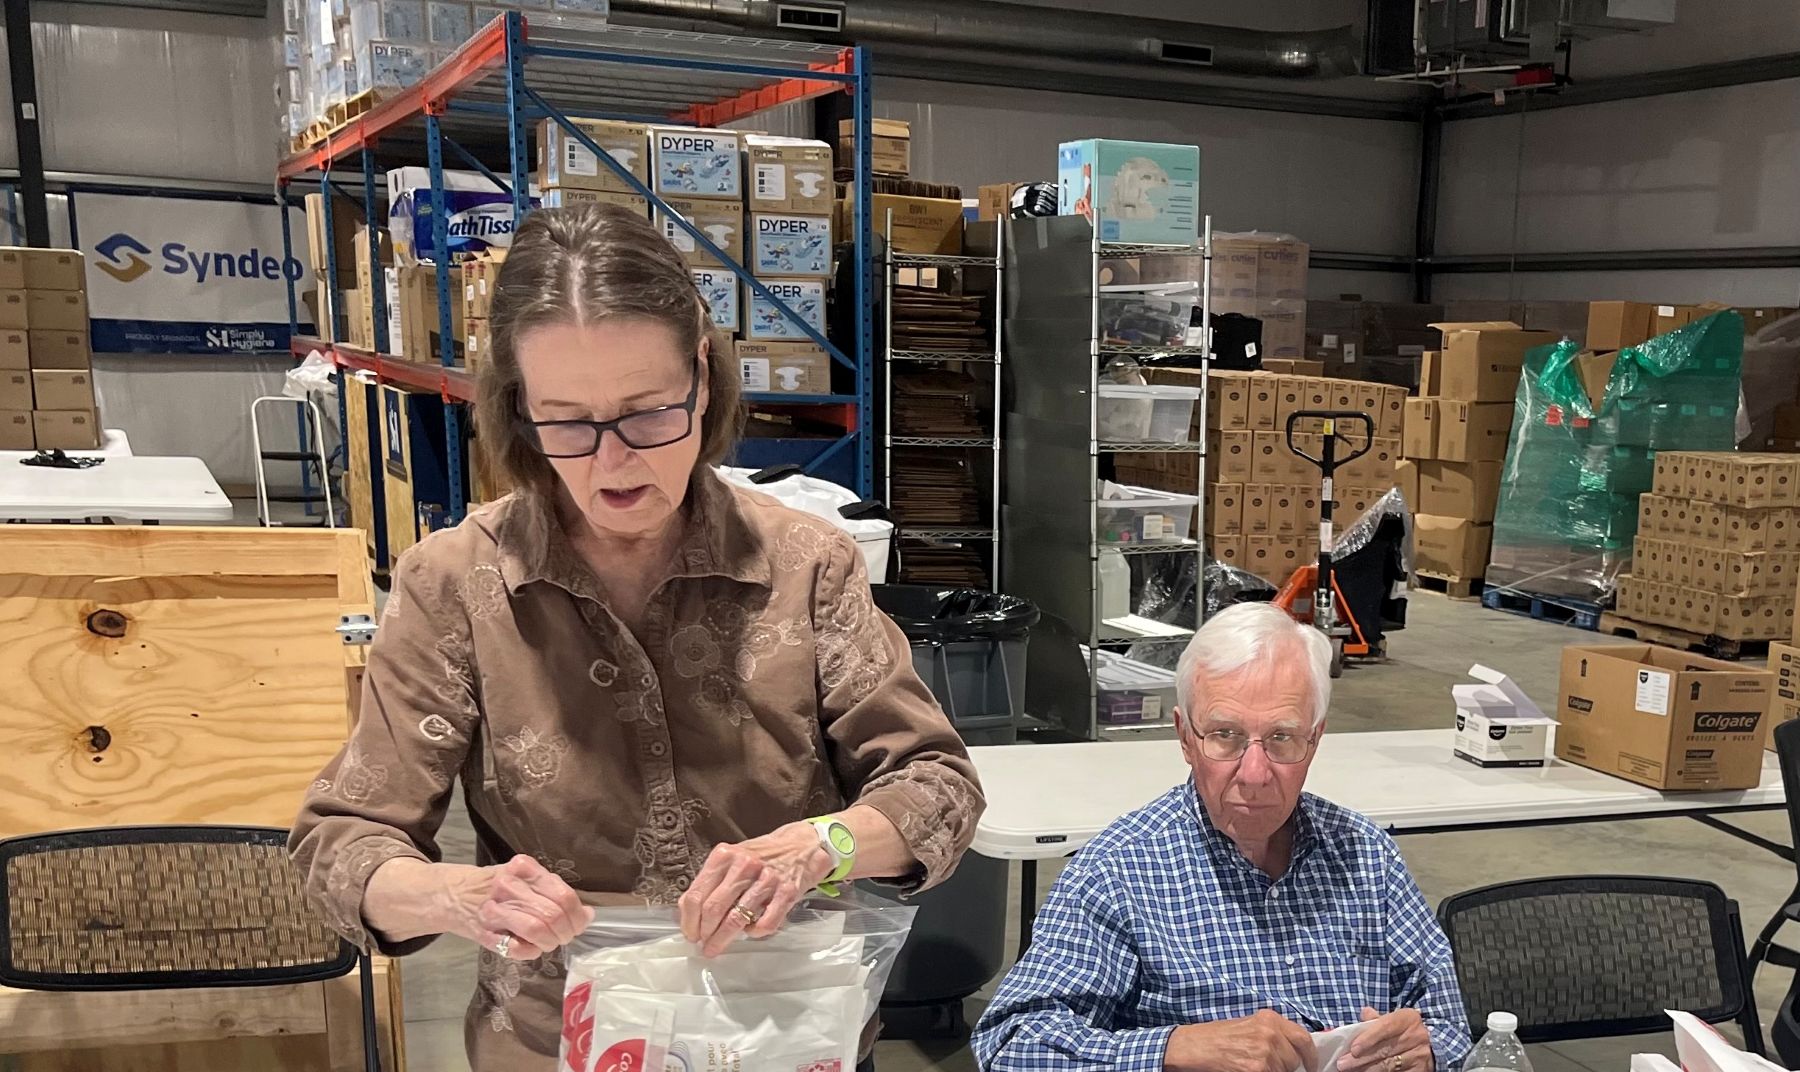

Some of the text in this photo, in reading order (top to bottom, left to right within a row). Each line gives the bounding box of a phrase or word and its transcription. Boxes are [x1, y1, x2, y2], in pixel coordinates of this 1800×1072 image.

[661, 137, 715, 152] DYPER
[567, 192, 597, 201] DYPER
[759, 219, 809, 233] DYPER
[162, 243, 303, 283] Syndeo
[230, 329, 264, 340] Simply
[231, 339, 275, 350] Hygiene
[739, 345, 767, 353] DYPER
[1697, 714, 1754, 731] Colgate
